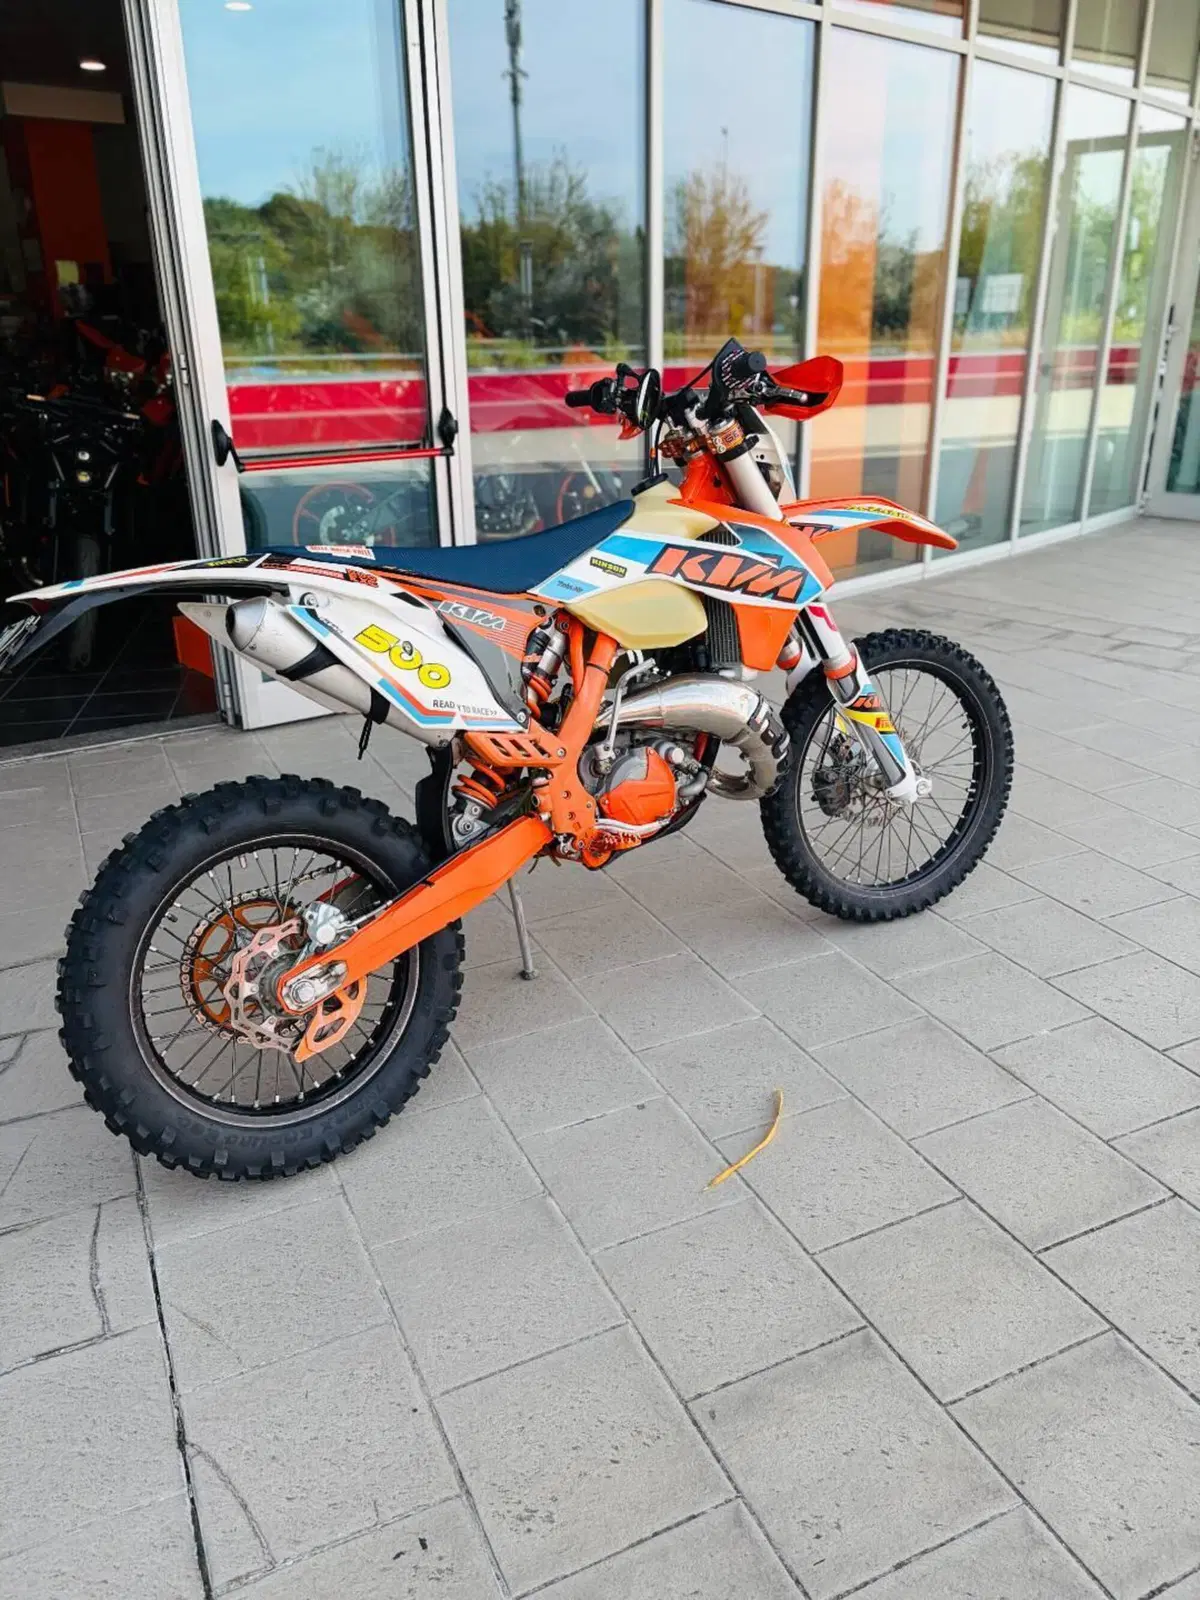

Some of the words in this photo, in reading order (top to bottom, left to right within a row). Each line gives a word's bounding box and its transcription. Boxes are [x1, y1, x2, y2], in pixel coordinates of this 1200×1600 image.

[647, 544, 806, 603] KTM
[438, 600, 508, 632] KTM
[353, 624, 451, 690] 500
